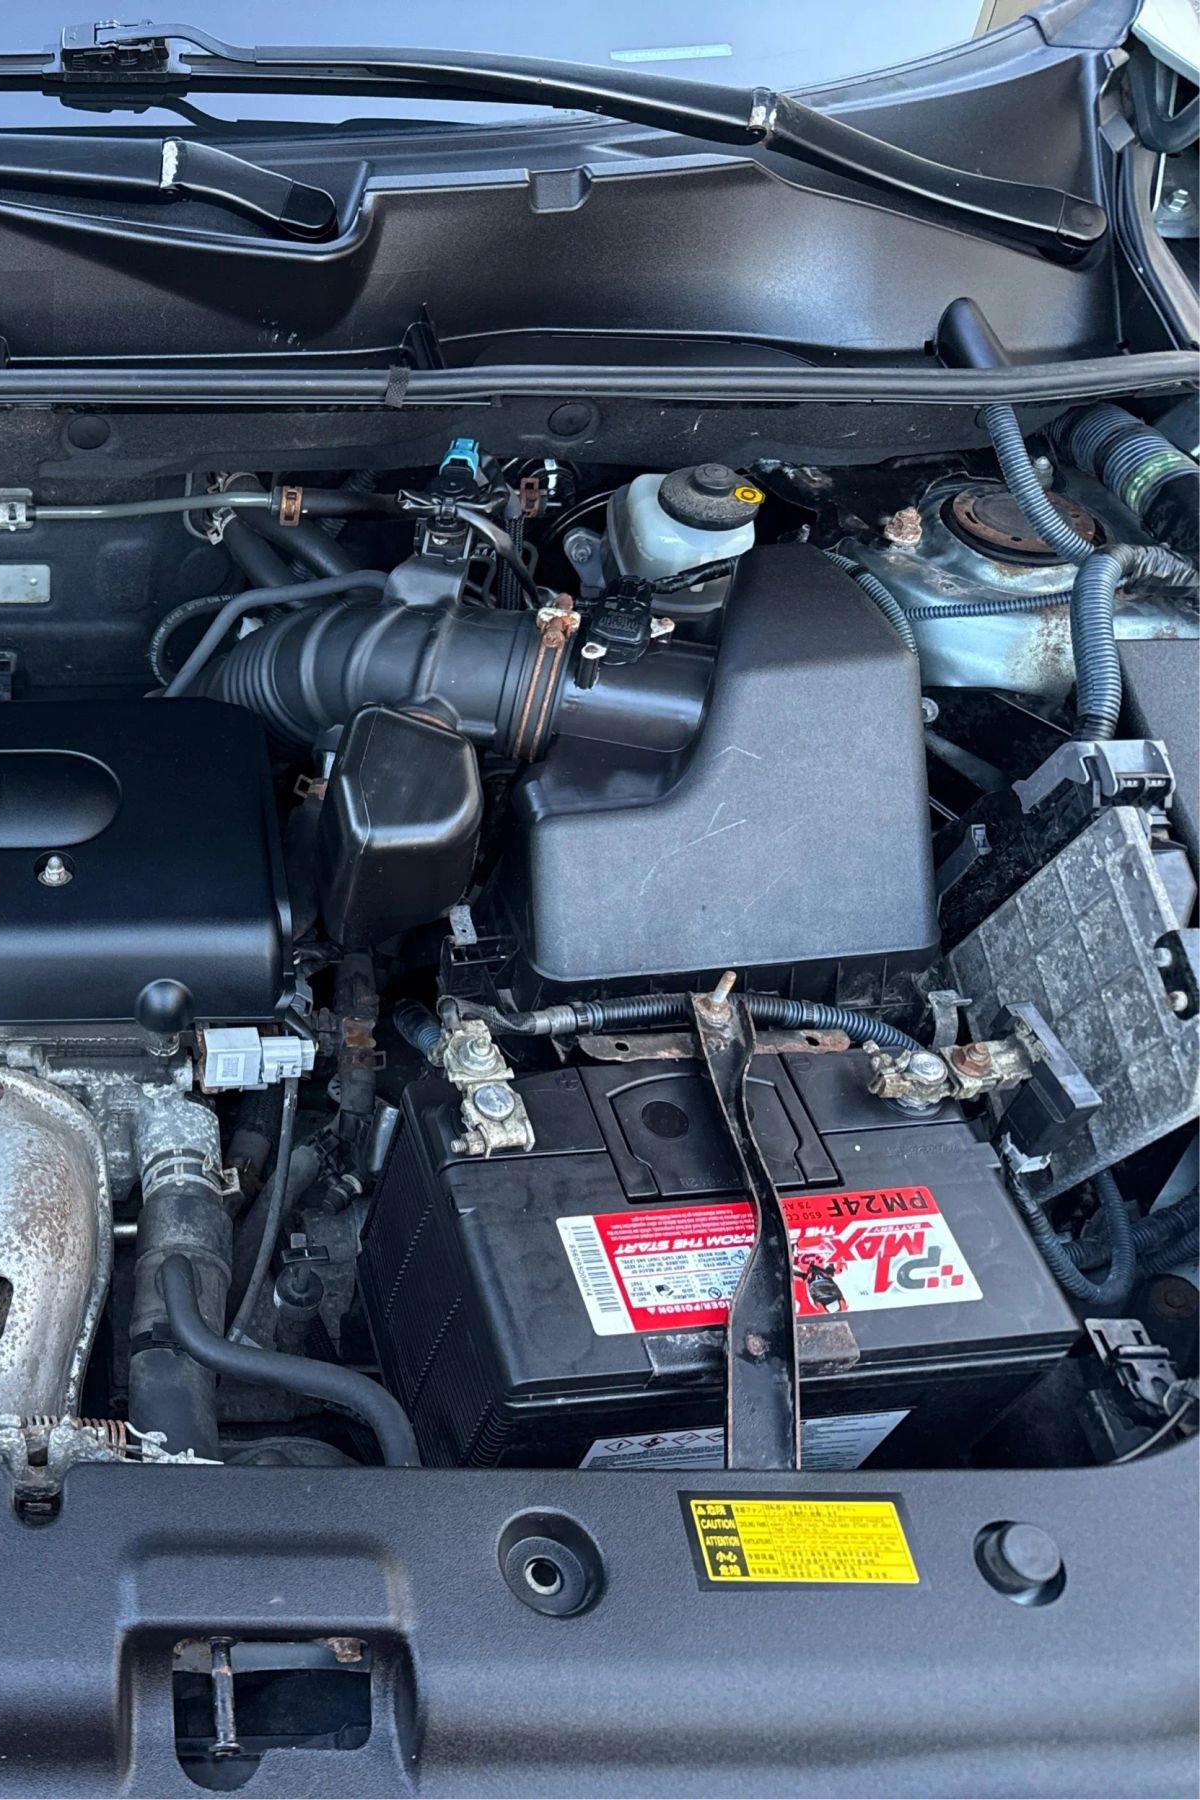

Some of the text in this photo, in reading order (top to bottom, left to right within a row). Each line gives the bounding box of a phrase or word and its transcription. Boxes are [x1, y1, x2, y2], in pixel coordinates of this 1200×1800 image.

[827, 1191, 928, 1217] PM24F
[802, 1211, 822, 1220] 650
[805, 1225, 836, 1238] THE
[874, 1222, 922, 1233] BATTERY
[613, 1233, 755, 1254] FROM THE START
[826, 1228, 925, 1263] MAX
[874, 1246, 941, 1294] P1
[700, 1518, 736, 1530] CAUTION
[705, 1535, 740, 1547] ATTENTION
[715, 1550, 738, 1563] 小心
